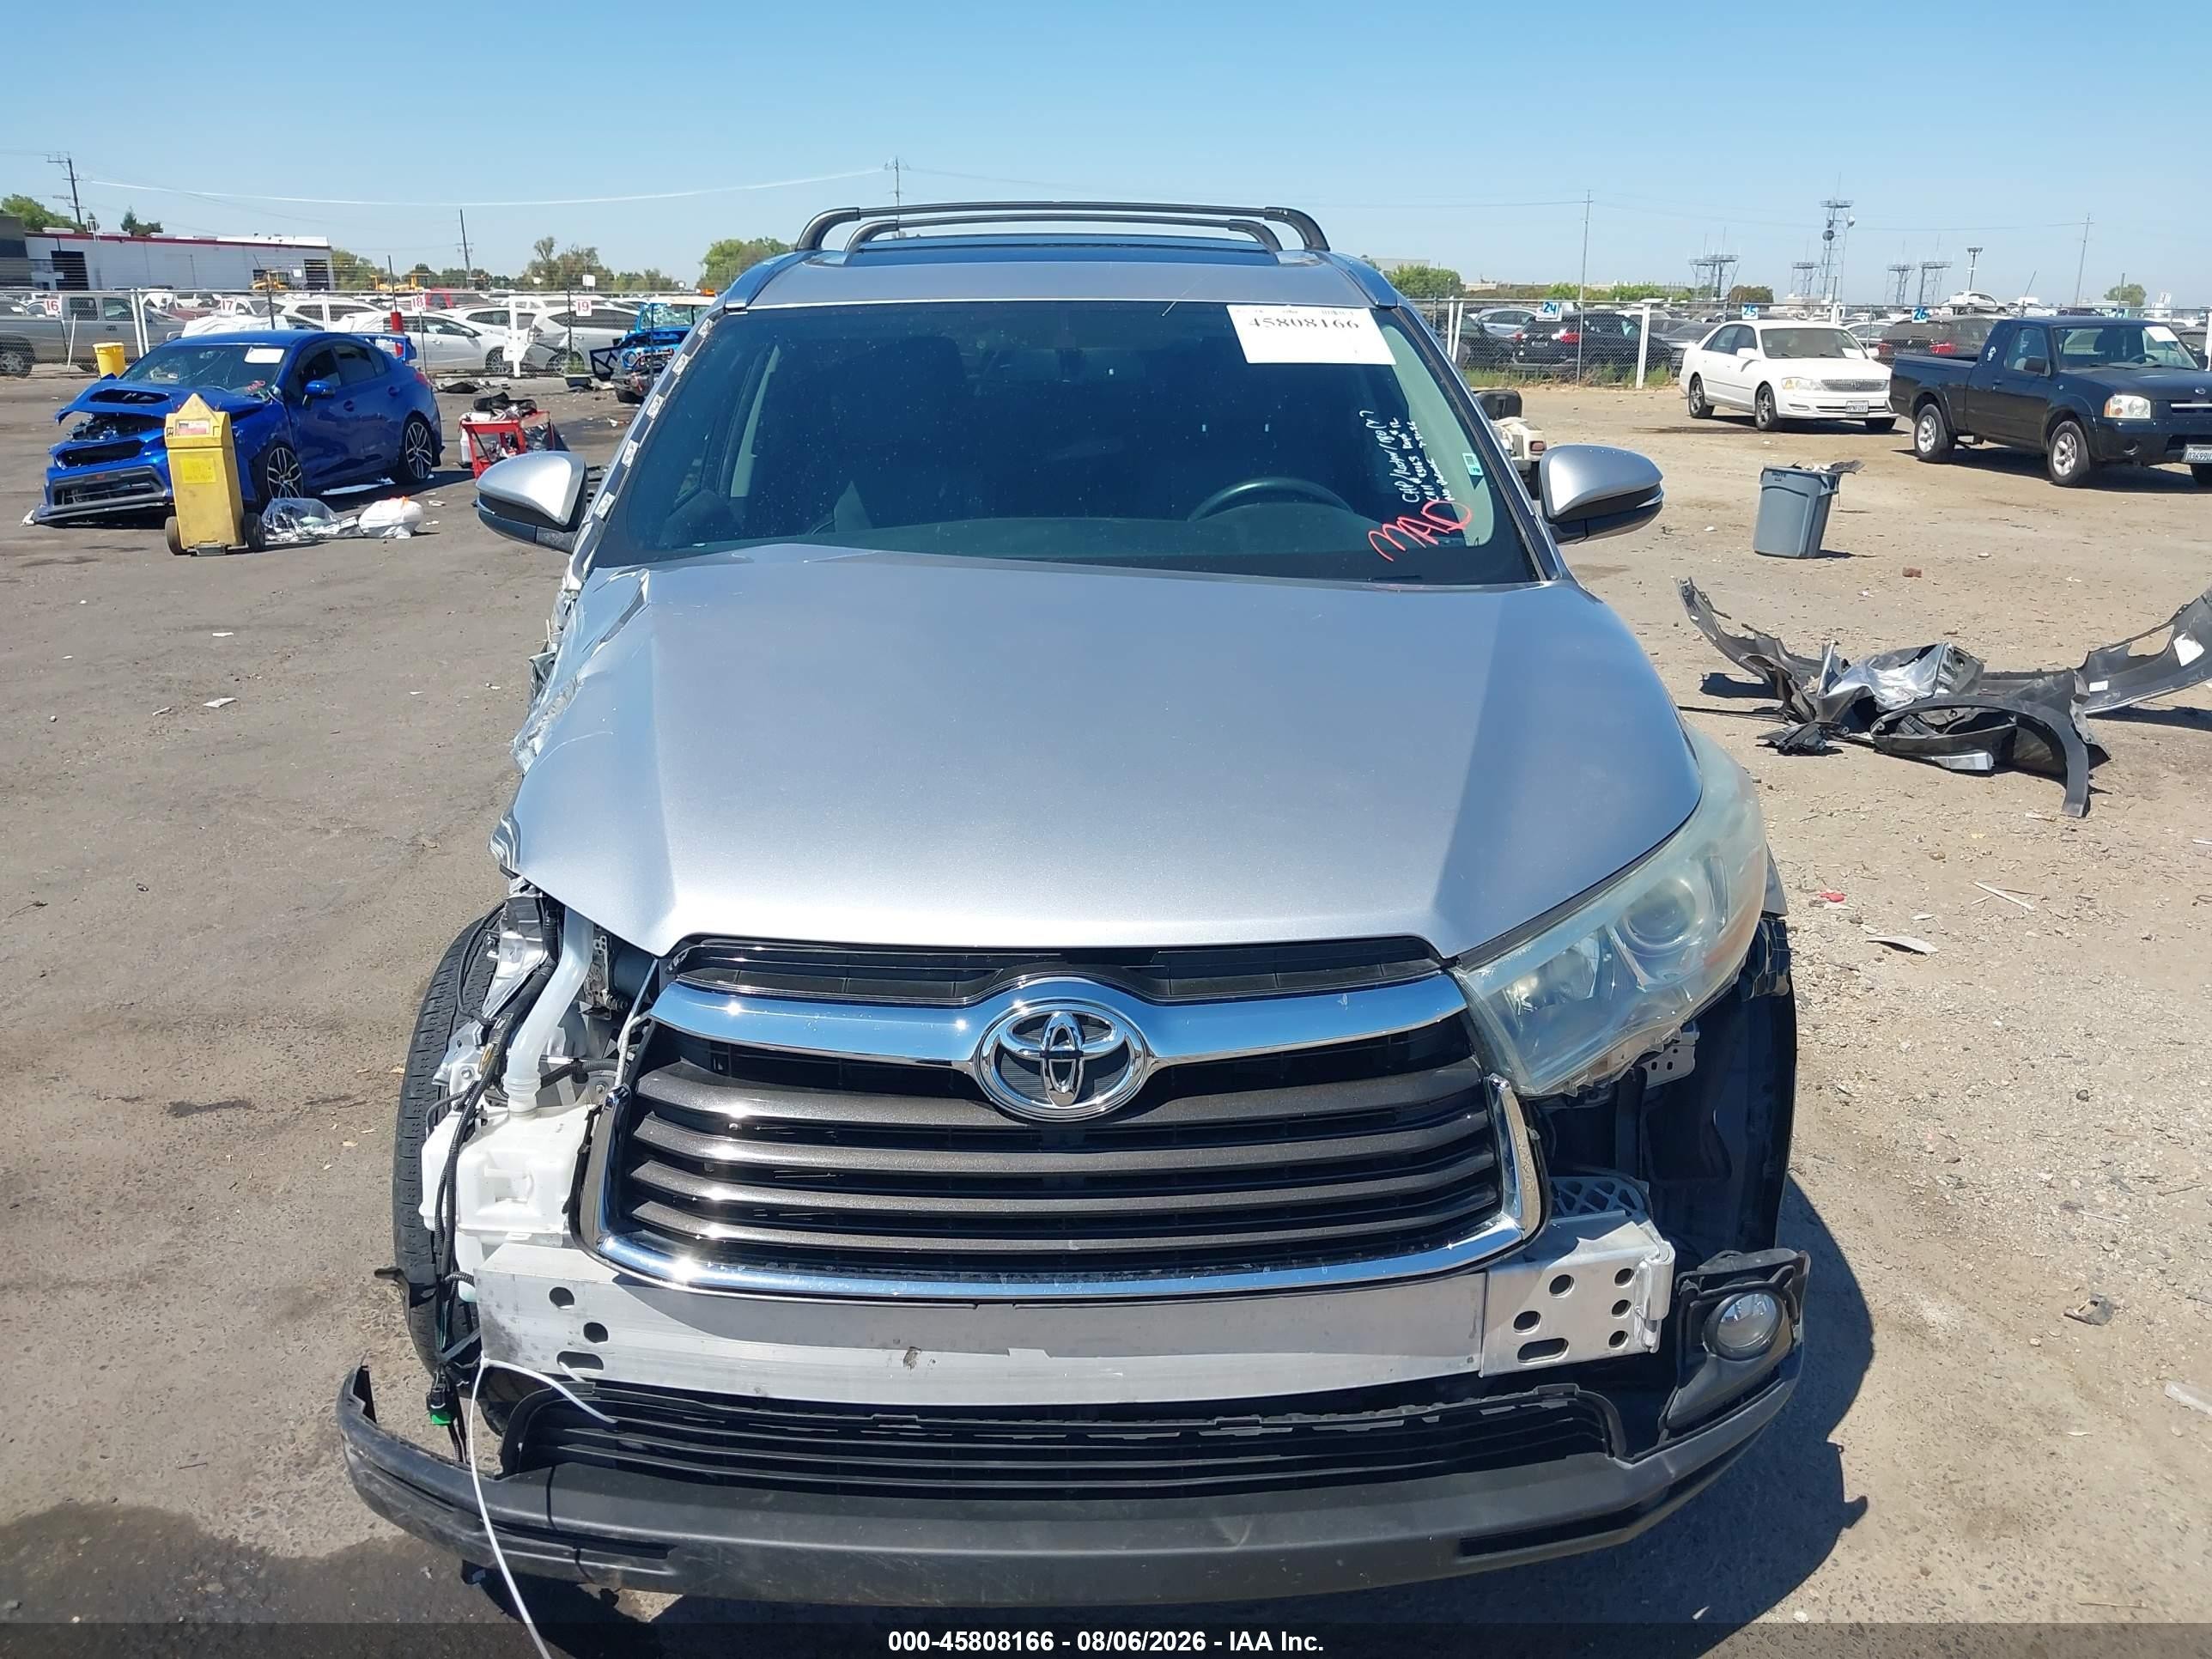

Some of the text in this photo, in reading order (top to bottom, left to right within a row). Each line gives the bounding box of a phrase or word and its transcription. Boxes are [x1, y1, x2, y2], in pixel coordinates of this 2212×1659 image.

[46, 300, 59, 312] 16
[221, 301, 234, 311] 17
[412, 296, 424, 307] 18
[577, 301, 589, 312] 19
[1543, 301, 1557, 315] 24
[1743, 305, 1757, 317] 25
[1913, 307, 1927, 320] 26
[1249, 317, 1359, 329] 45808166
